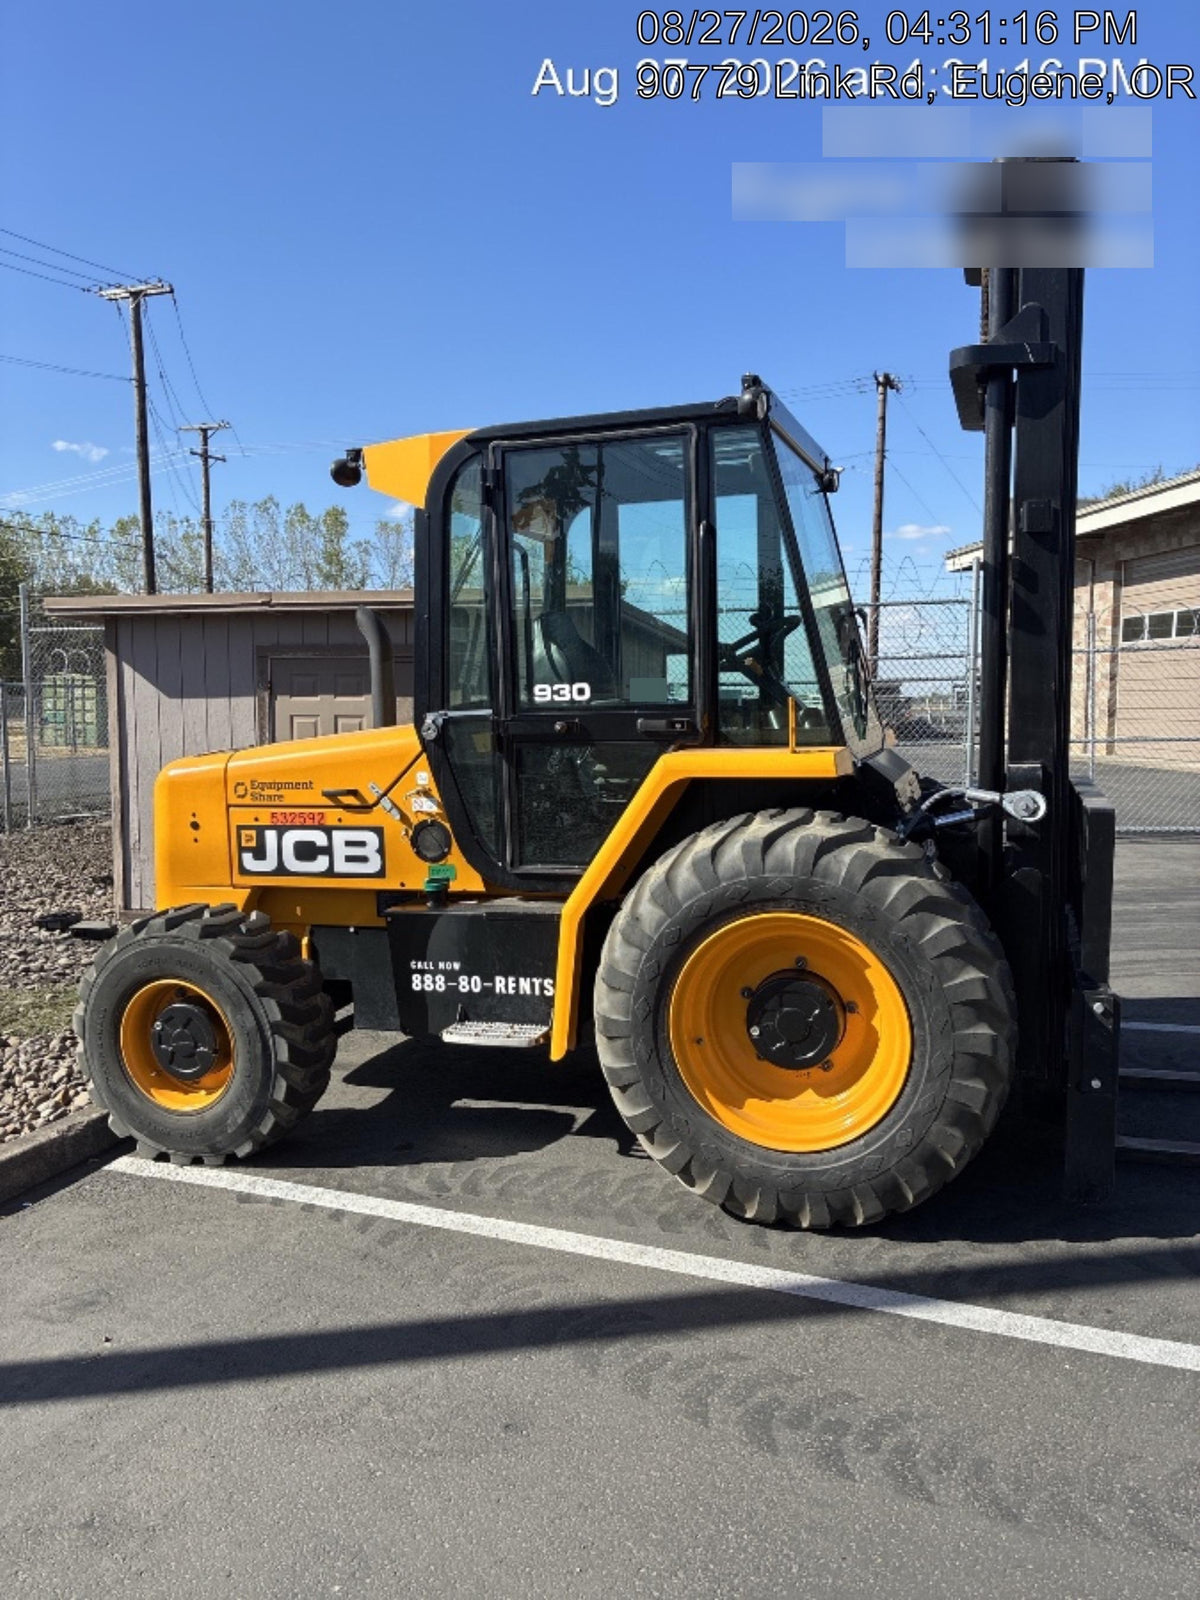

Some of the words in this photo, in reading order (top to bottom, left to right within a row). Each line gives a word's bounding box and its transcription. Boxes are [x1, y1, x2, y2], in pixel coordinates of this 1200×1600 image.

[533, 682, 591, 701] 930
[250, 780, 314, 791] Equipment
[250, 790, 285, 801] Share
[270, 812, 325, 825] 532592
[241, 829, 382, 874] JCB
[410, 960, 434, 970] CALL
[438, 961, 461, 971] NOW
[411, 974, 554, 996] 888-80-RENTS
